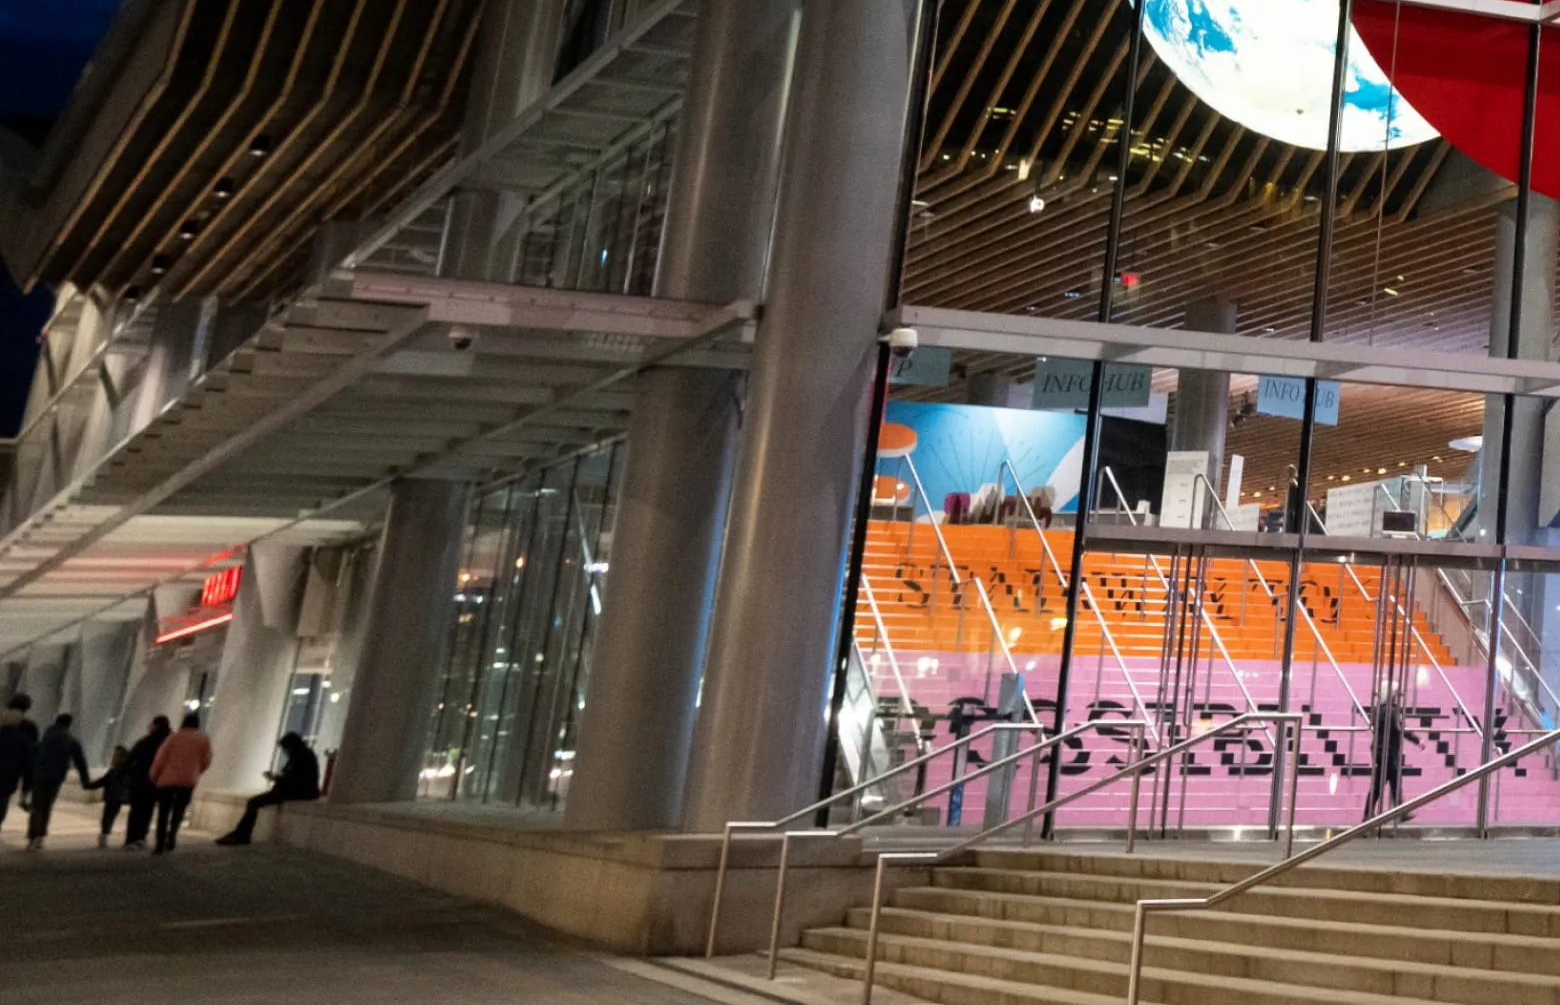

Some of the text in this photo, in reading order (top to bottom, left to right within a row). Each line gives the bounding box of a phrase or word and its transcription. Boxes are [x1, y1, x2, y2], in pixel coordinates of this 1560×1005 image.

[1042, 372, 1092, 393] INFO
[1263, 378, 1335, 408] INFO UB
